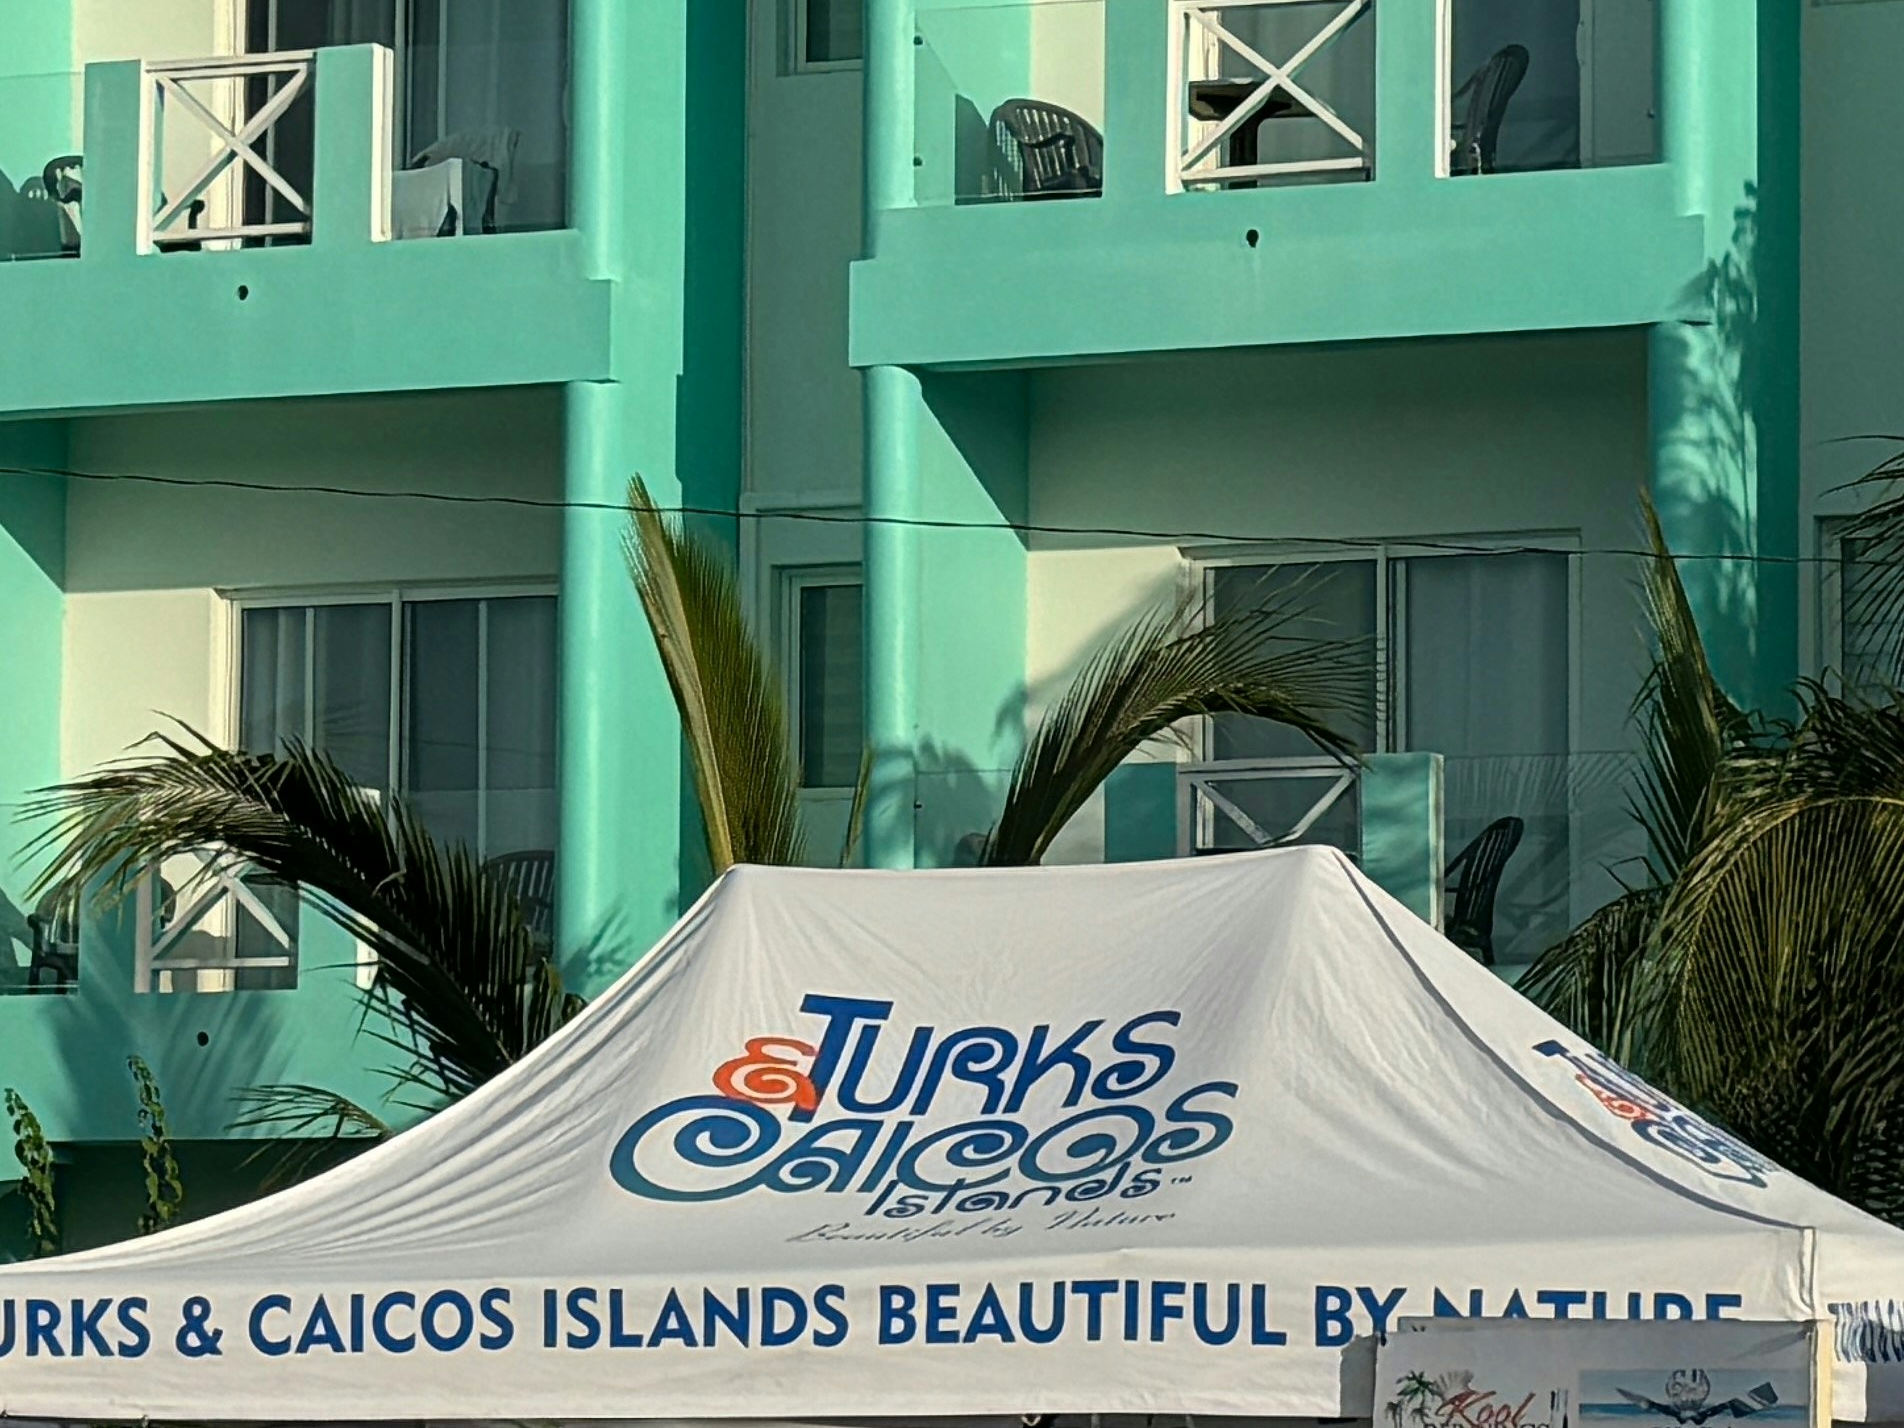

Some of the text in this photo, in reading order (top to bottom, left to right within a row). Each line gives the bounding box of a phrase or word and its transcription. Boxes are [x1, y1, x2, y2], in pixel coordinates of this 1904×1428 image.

[175, 1295, 223, 1358] &
[248, 1287, 514, 1356] CAICOS
[544, 1283, 849, 1350] ISLANDS
[878, 1279, 1287, 1347] BEAUTIFUL
[1315, 1285, 1407, 1347] BY
